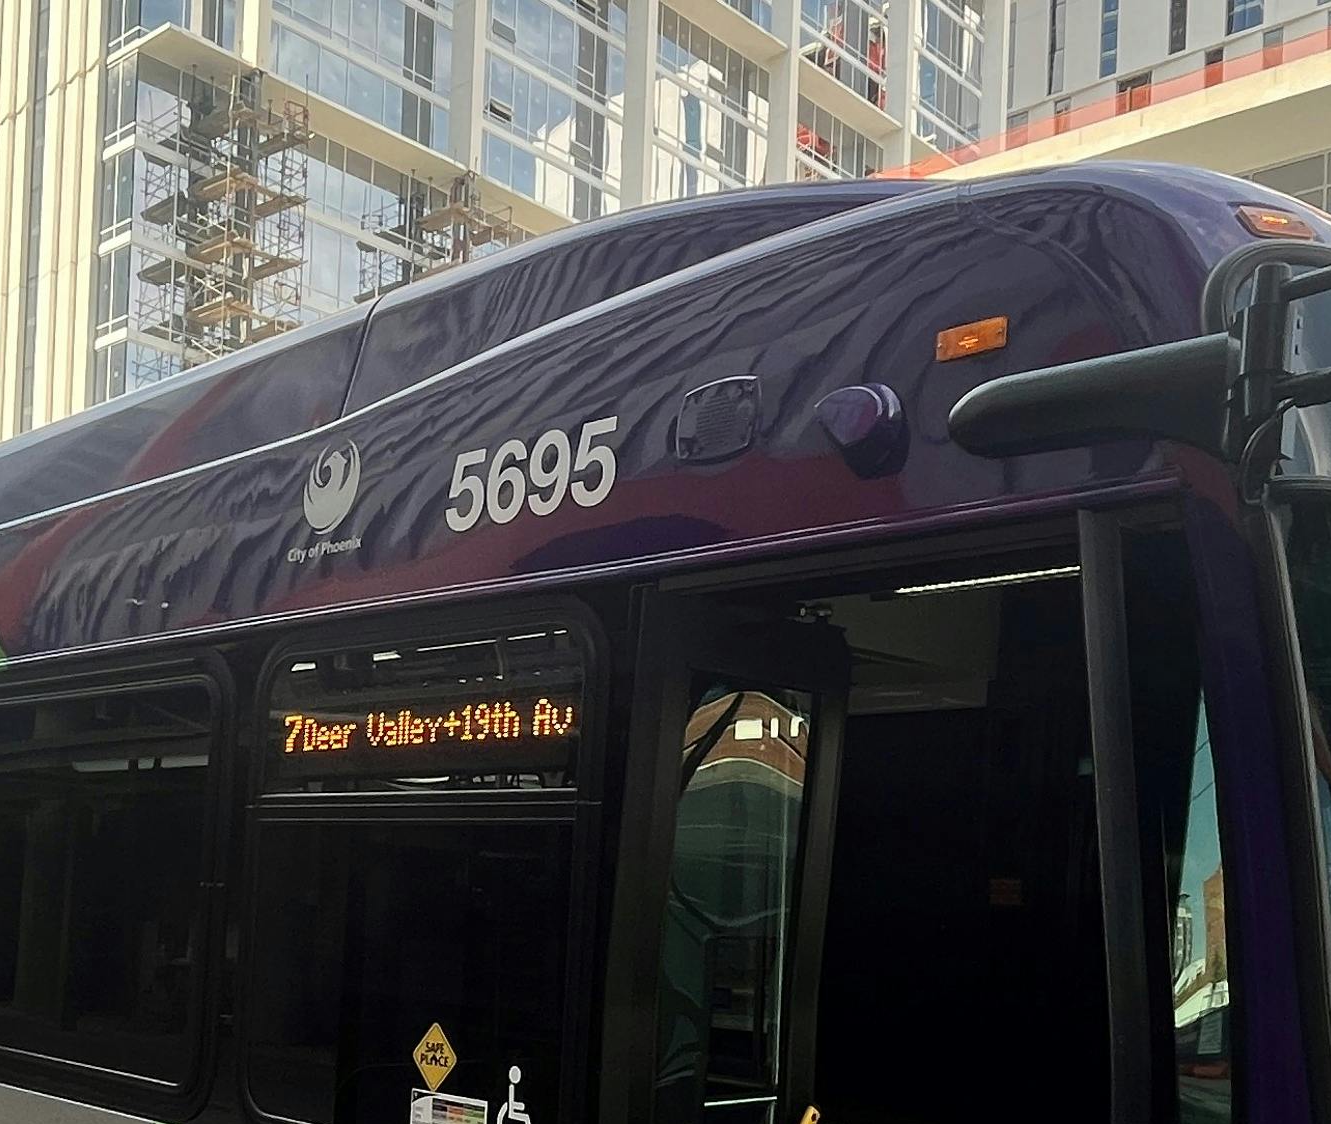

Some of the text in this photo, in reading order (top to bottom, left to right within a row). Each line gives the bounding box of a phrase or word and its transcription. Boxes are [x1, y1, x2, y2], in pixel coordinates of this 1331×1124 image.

[445, 416, 617, 532] 5695
[287, 536, 362, 563] City of Phoenix
[532, 698, 573, 736] Av
[420, 1053, 449, 1067] PLACE
[425, 1041, 445, 1055] SAFE
